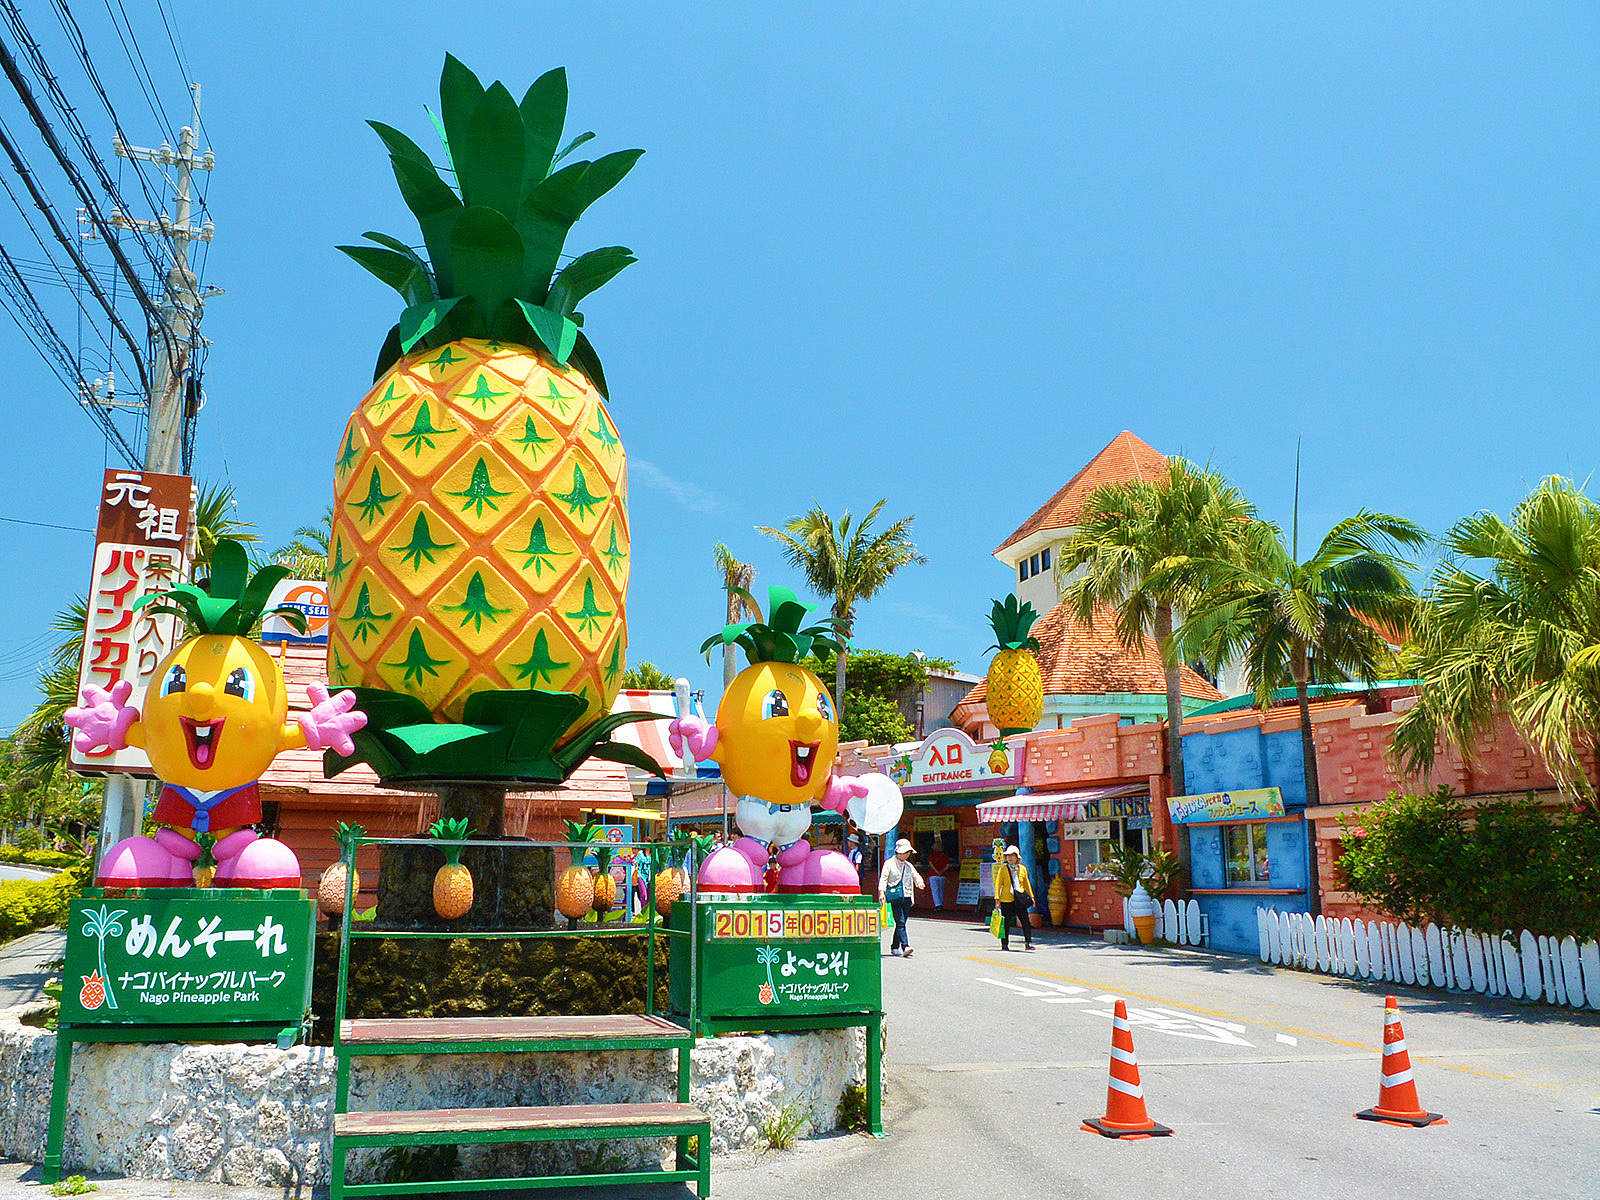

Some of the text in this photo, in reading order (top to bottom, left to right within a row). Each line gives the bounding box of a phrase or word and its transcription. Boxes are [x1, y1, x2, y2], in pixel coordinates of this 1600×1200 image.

[105, 474, 183, 541] 元祖
[928, 743, 963, 767] 入口
[922, 769, 972, 783] ENTRANCE
[126, 915, 288, 957] めんそーれ
[717, 913, 877, 936] 2015年05月10日
[140, 990, 260, 1005] Nago Pineapple Park
[789, 994, 803, 1002] Nago
[803, 993, 829, 1001] Pineapple
